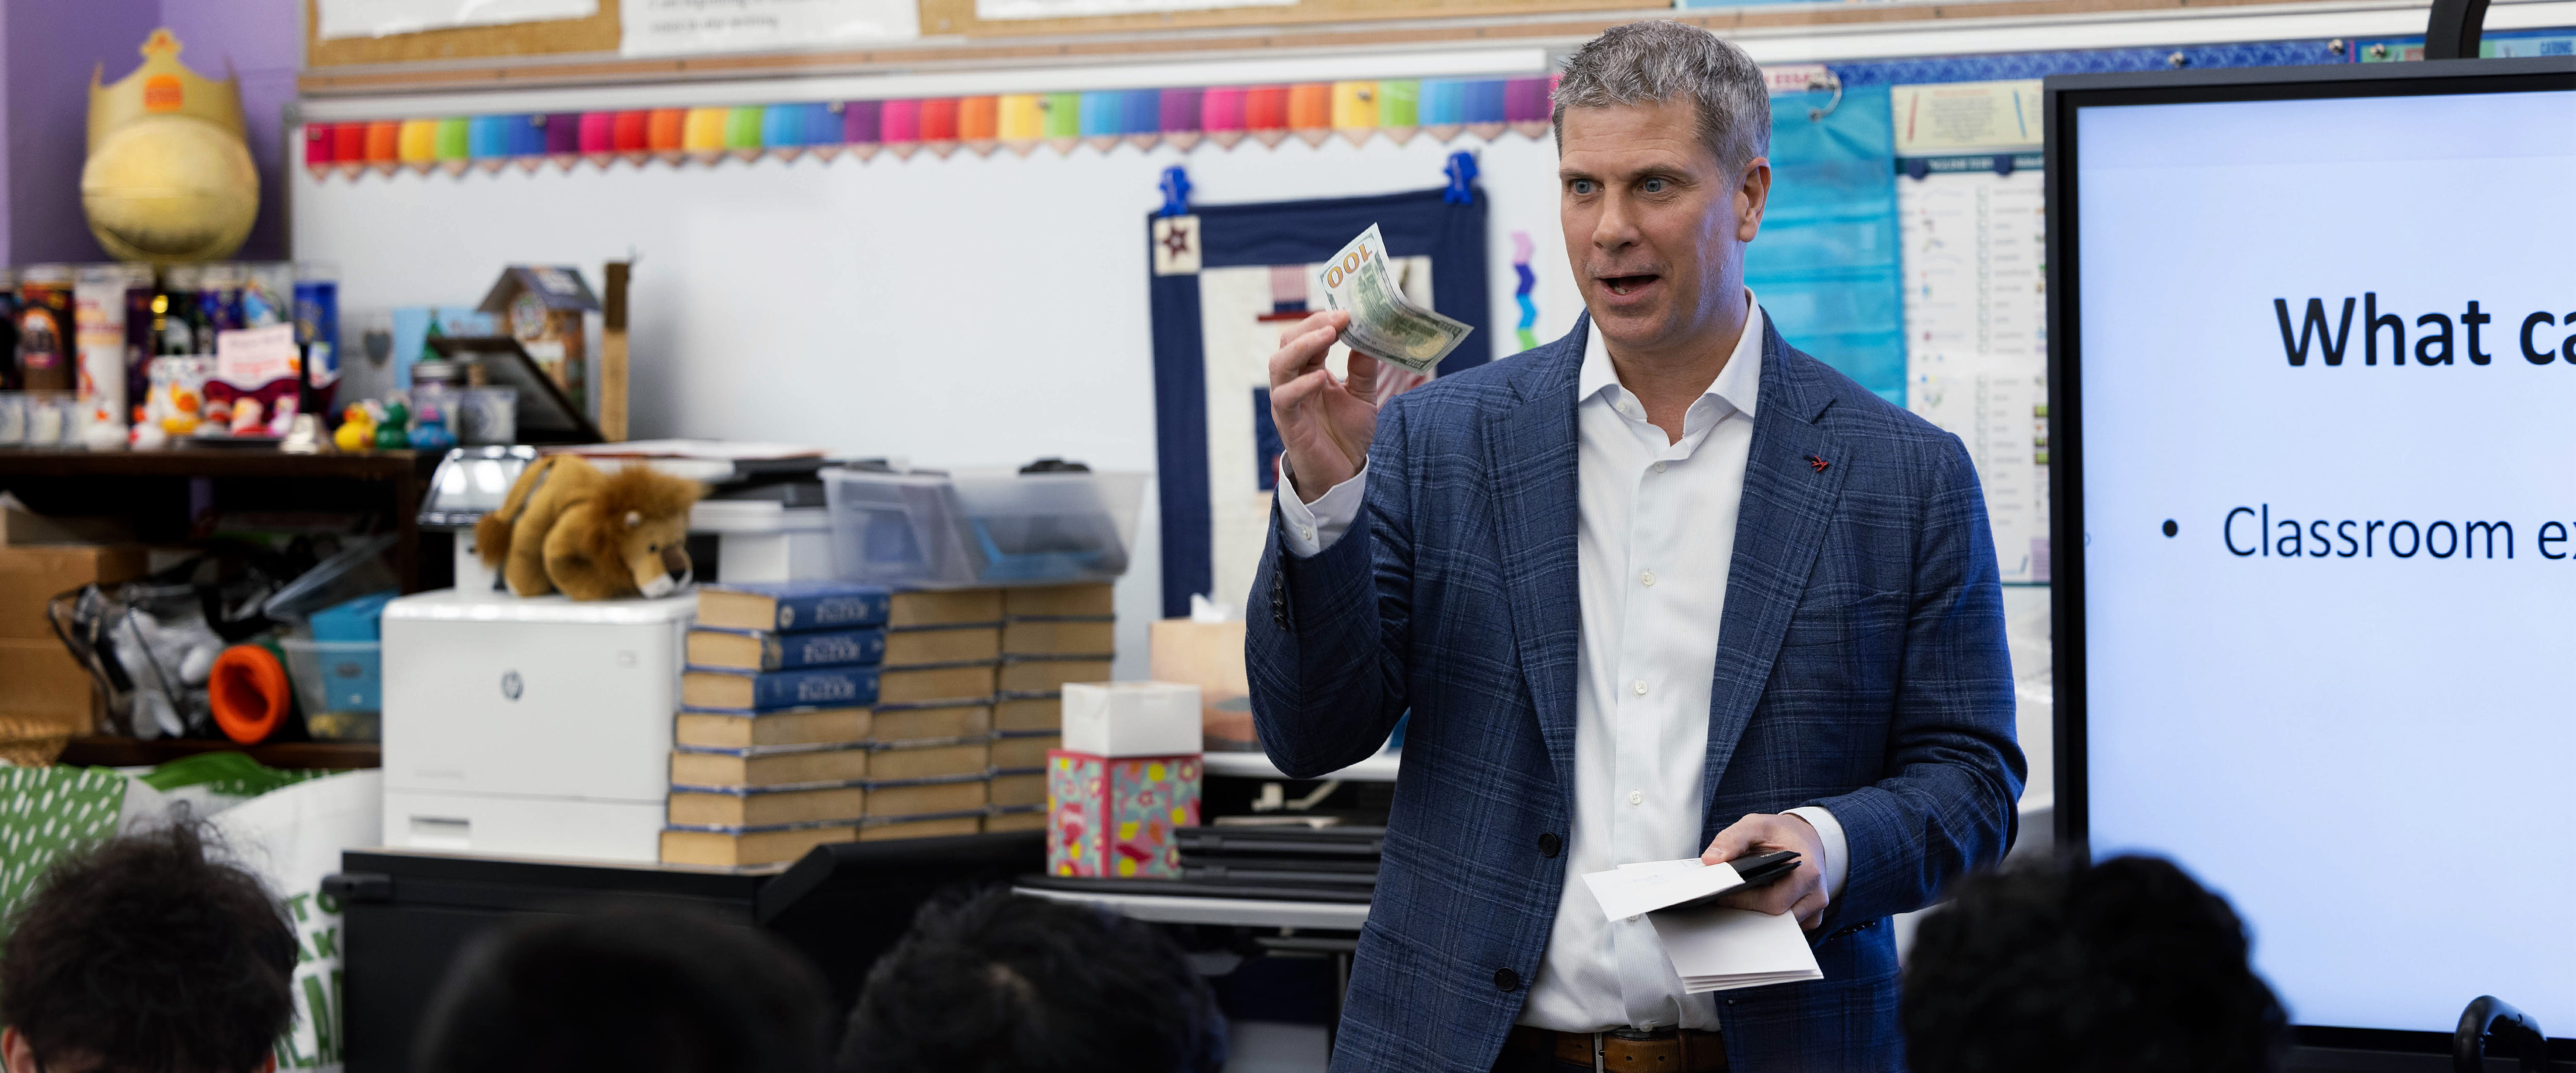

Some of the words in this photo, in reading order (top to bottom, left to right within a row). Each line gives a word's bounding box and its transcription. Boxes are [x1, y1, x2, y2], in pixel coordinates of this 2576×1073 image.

[1328, 243, 1372, 288] 100
[2274, 292, 2492, 366] What
[2224, 503, 2514, 559] Classroom
